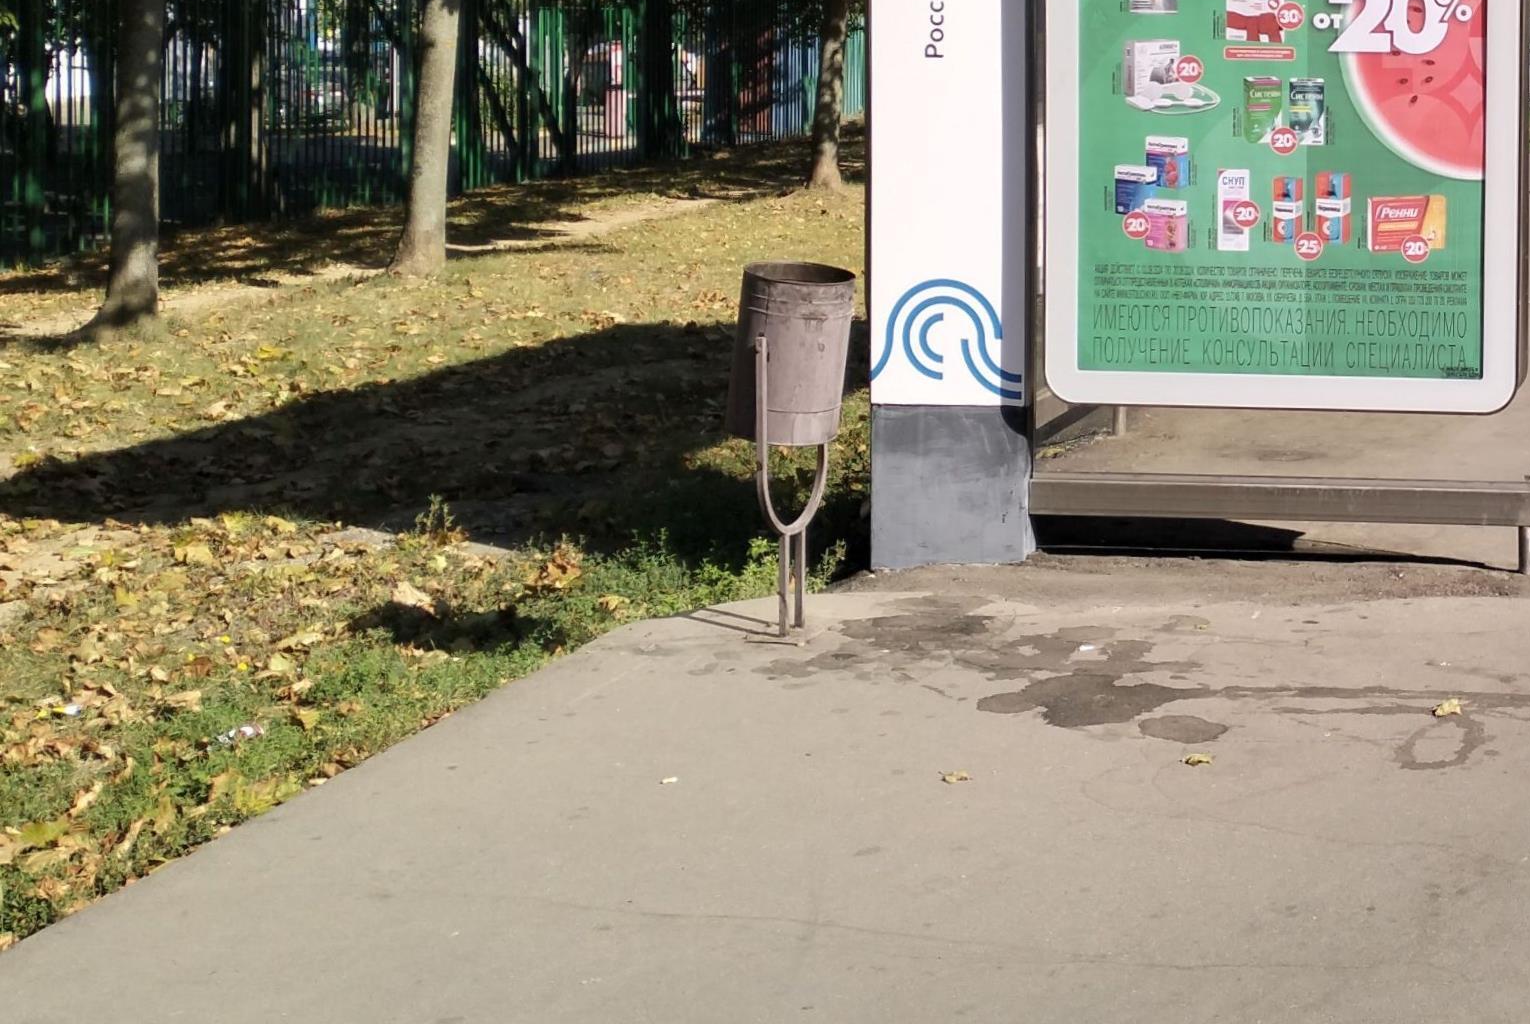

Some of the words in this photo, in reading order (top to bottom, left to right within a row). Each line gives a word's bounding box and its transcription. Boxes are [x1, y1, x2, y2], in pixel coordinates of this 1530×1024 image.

[1313, 13, 1343, 29] от
[1093, 304, 1170, 332] ИМЕЮТСЯ
[1176, 306, 1350, 336] ПРОТИВОПОКАЗАНИЯ.
[1356, 309, 1468, 341] НЕОБХОДИМО
[1093, 336, 1191, 365] ПОЛУЧЕНИЕ
[1202, 338, 1334, 370] КОНСУЛЬТАЦИИ
[1346, 342, 1467, 372] СПЕЦИАЛИСТА
